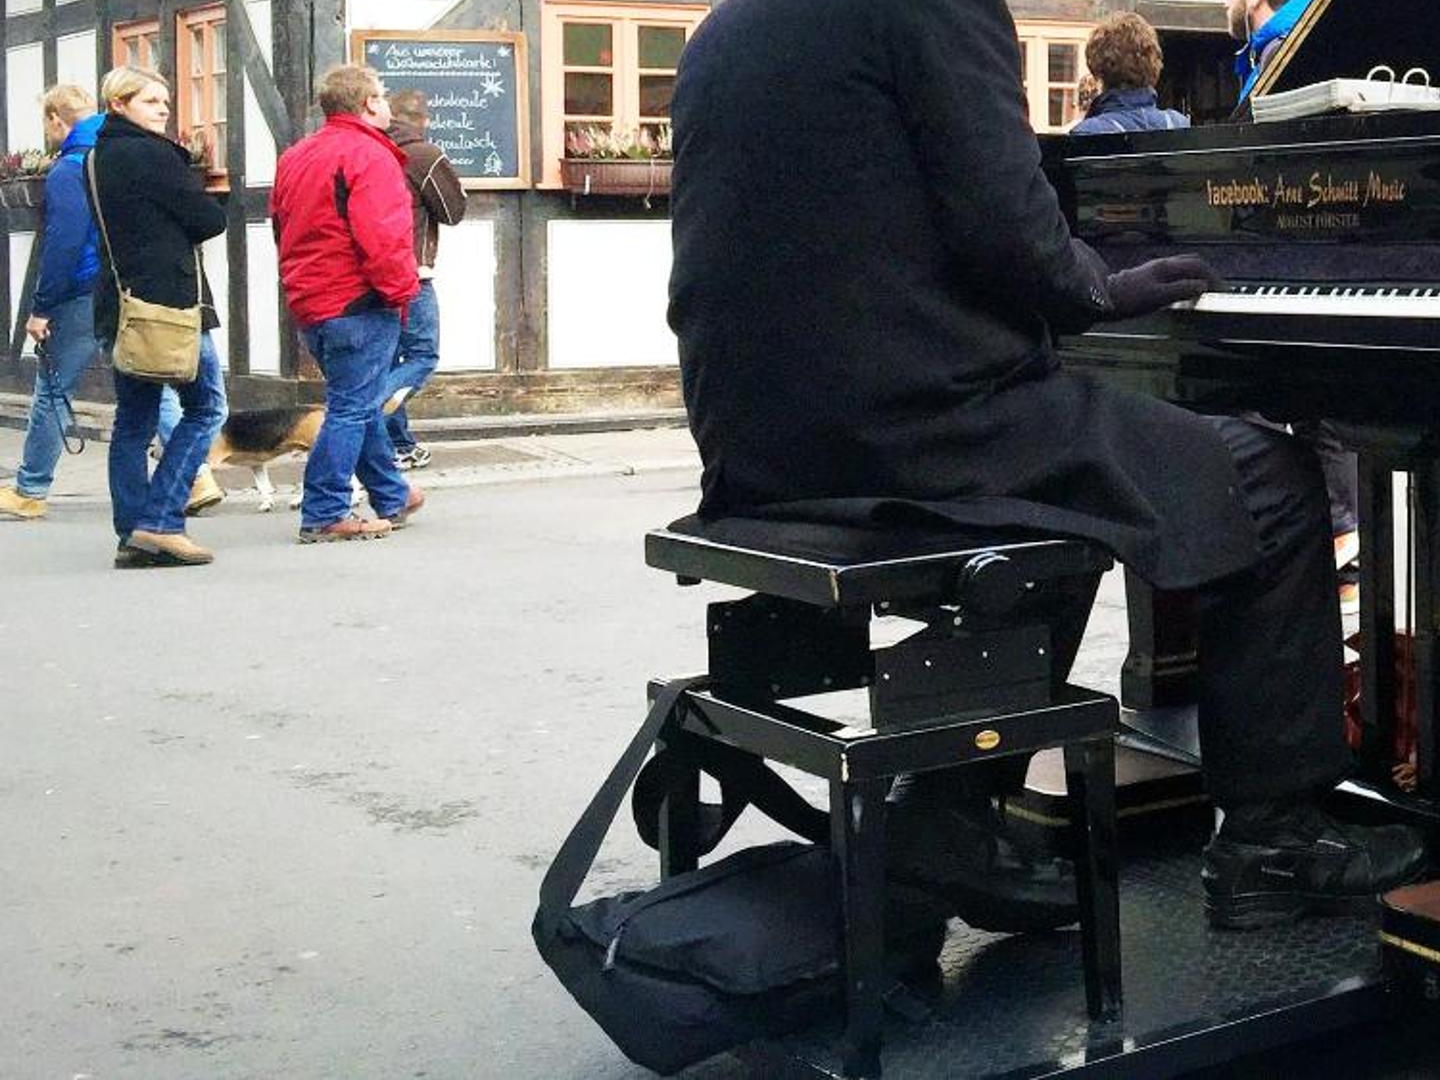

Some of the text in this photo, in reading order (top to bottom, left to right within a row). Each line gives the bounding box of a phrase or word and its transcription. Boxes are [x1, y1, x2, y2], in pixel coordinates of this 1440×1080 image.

[1206, 176, 1269, 206] facebook:
[1306, 171, 1359, 208] Schmitt
[1362, 169, 1406, 208] Music
